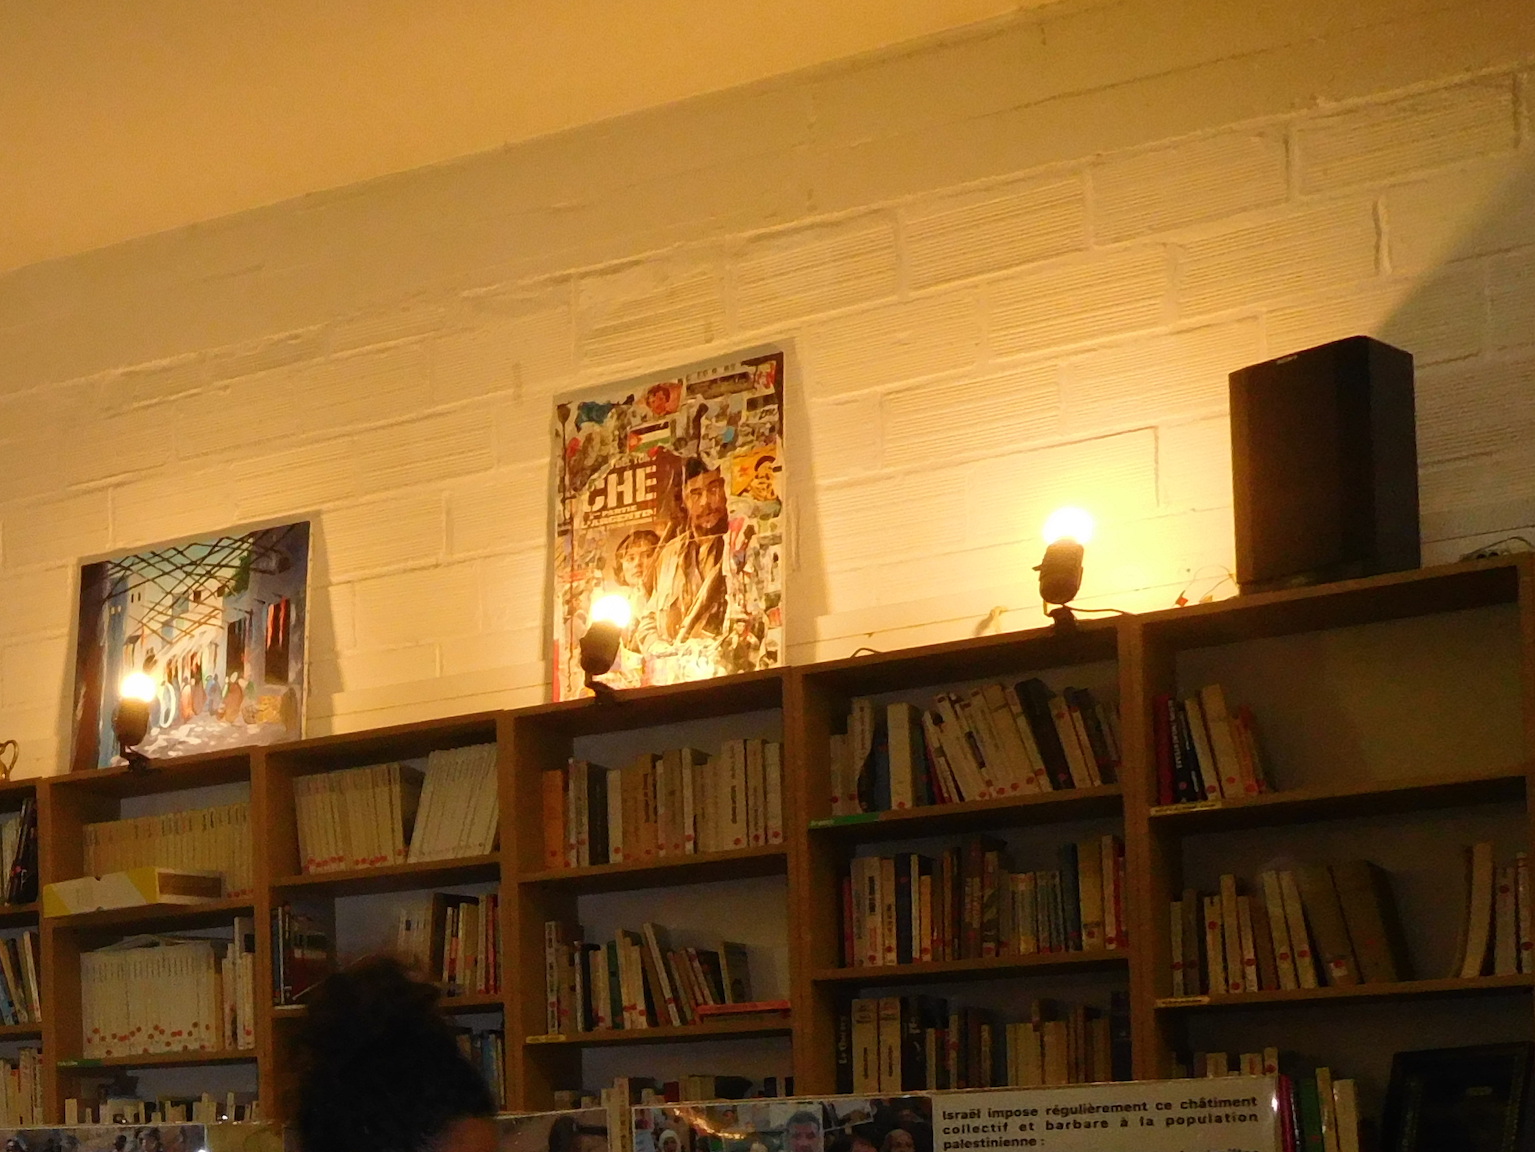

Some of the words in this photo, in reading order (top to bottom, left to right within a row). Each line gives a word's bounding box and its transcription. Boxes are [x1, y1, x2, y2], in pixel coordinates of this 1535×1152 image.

[582, 465, 657, 512] CHE
[942, 1108, 981, 1120] Israël
[988, 1107, 1038, 1120] impose
[1046, 1101, 1147, 1118] régulièrement
[1155, 1102, 1172, 1110] ce
[1180, 1096, 1258, 1109] châtiment
[942, 1122, 1008, 1135] collectif
[1019, 1124, 1034, 1132] et
[1045, 1119, 1109, 1131] barbare
[1120, 1117, 1128, 1127] à
[1140, 1116, 1154, 1126] la
[1165, 1112, 1258, 1127] population
[943, 1136, 1037, 1151] palestinienne
